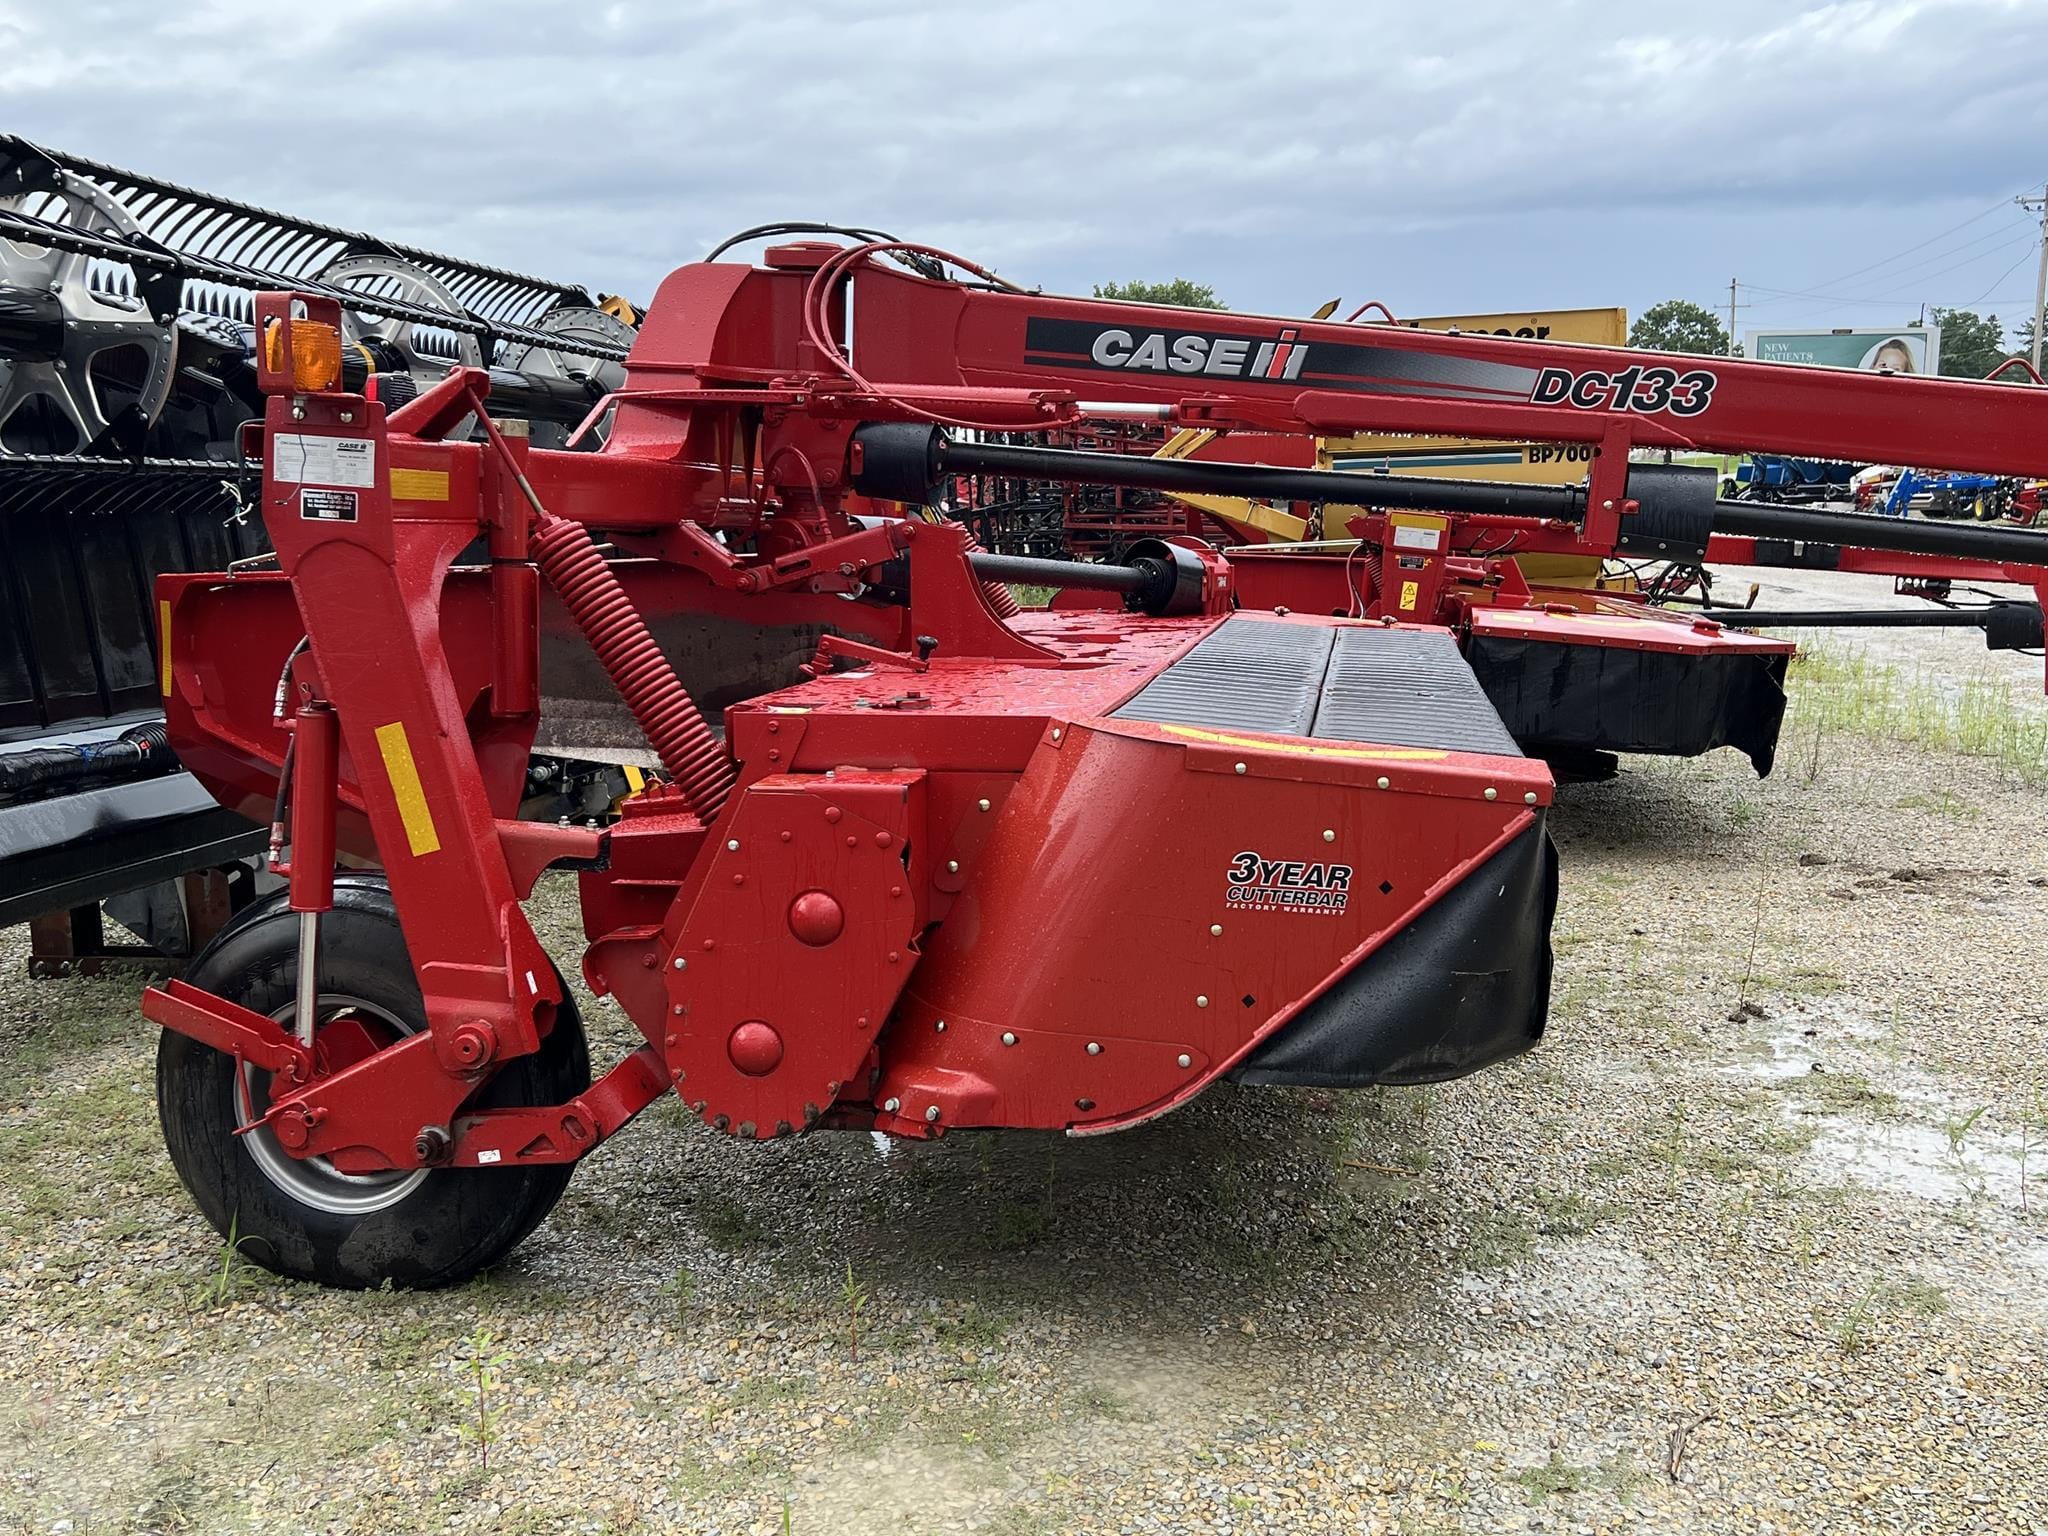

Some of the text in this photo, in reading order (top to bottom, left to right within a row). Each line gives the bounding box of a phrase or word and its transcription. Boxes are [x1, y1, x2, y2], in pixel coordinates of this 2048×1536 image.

[1091, 329, 1250, 375] CASE
[1764, 343, 1790, 352] NEW
[1764, 352, 1813, 361] PATIENTS
[1530, 365, 1718, 417] DC133
[1226, 886, 1348, 908] CUTTERBAR
[1226, 902, 1346, 916] FACTORY WARRANTY
